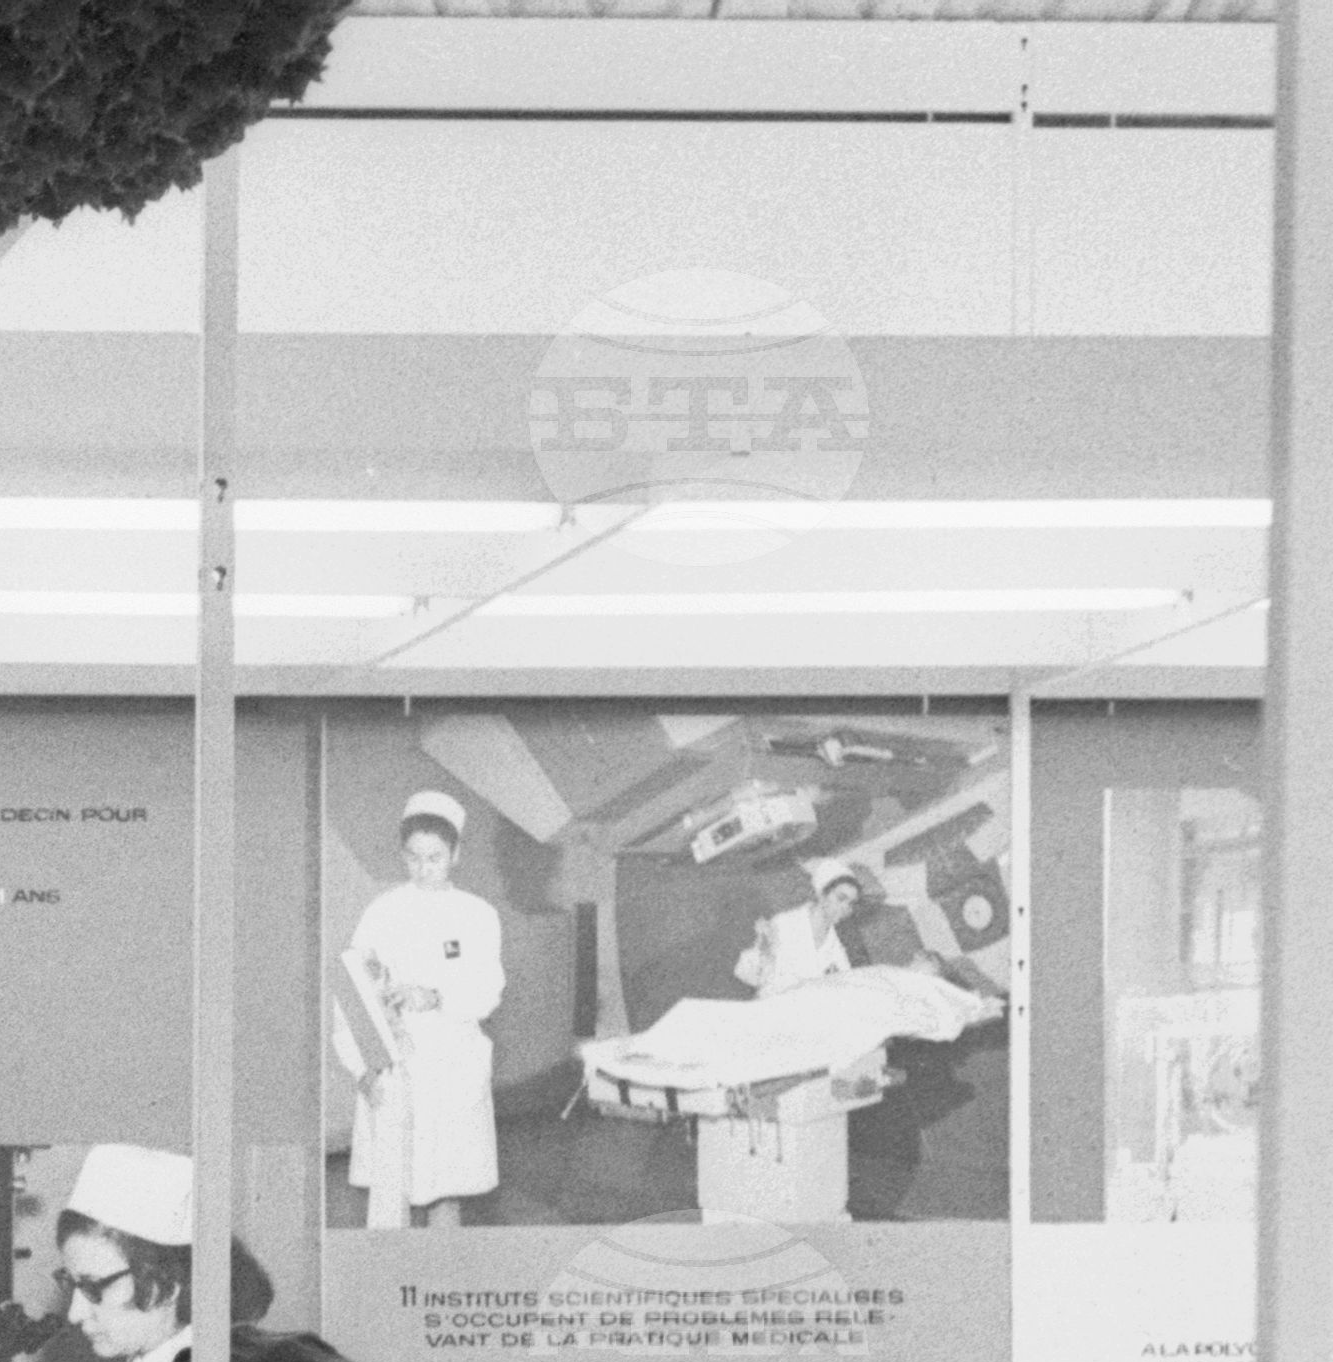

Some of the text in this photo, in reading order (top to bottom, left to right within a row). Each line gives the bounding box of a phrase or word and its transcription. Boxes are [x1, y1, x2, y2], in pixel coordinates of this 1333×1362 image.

[81, 807, 148, 823] POUR
[12, 889, 61, 904] ANS
[399, 1285, 905, 1308] 11 INSTITUTS SCIENTIFIQUES SPECIALISES
[423, 1311, 588, 1328] S'OCCUPENT
[599, 1311, 634, 1327] DE
[644, 1309, 805, 1326] PROBLEMES
[425, 1330, 864, 1348] VANT DE LA PRATIQUE MEDICALE
